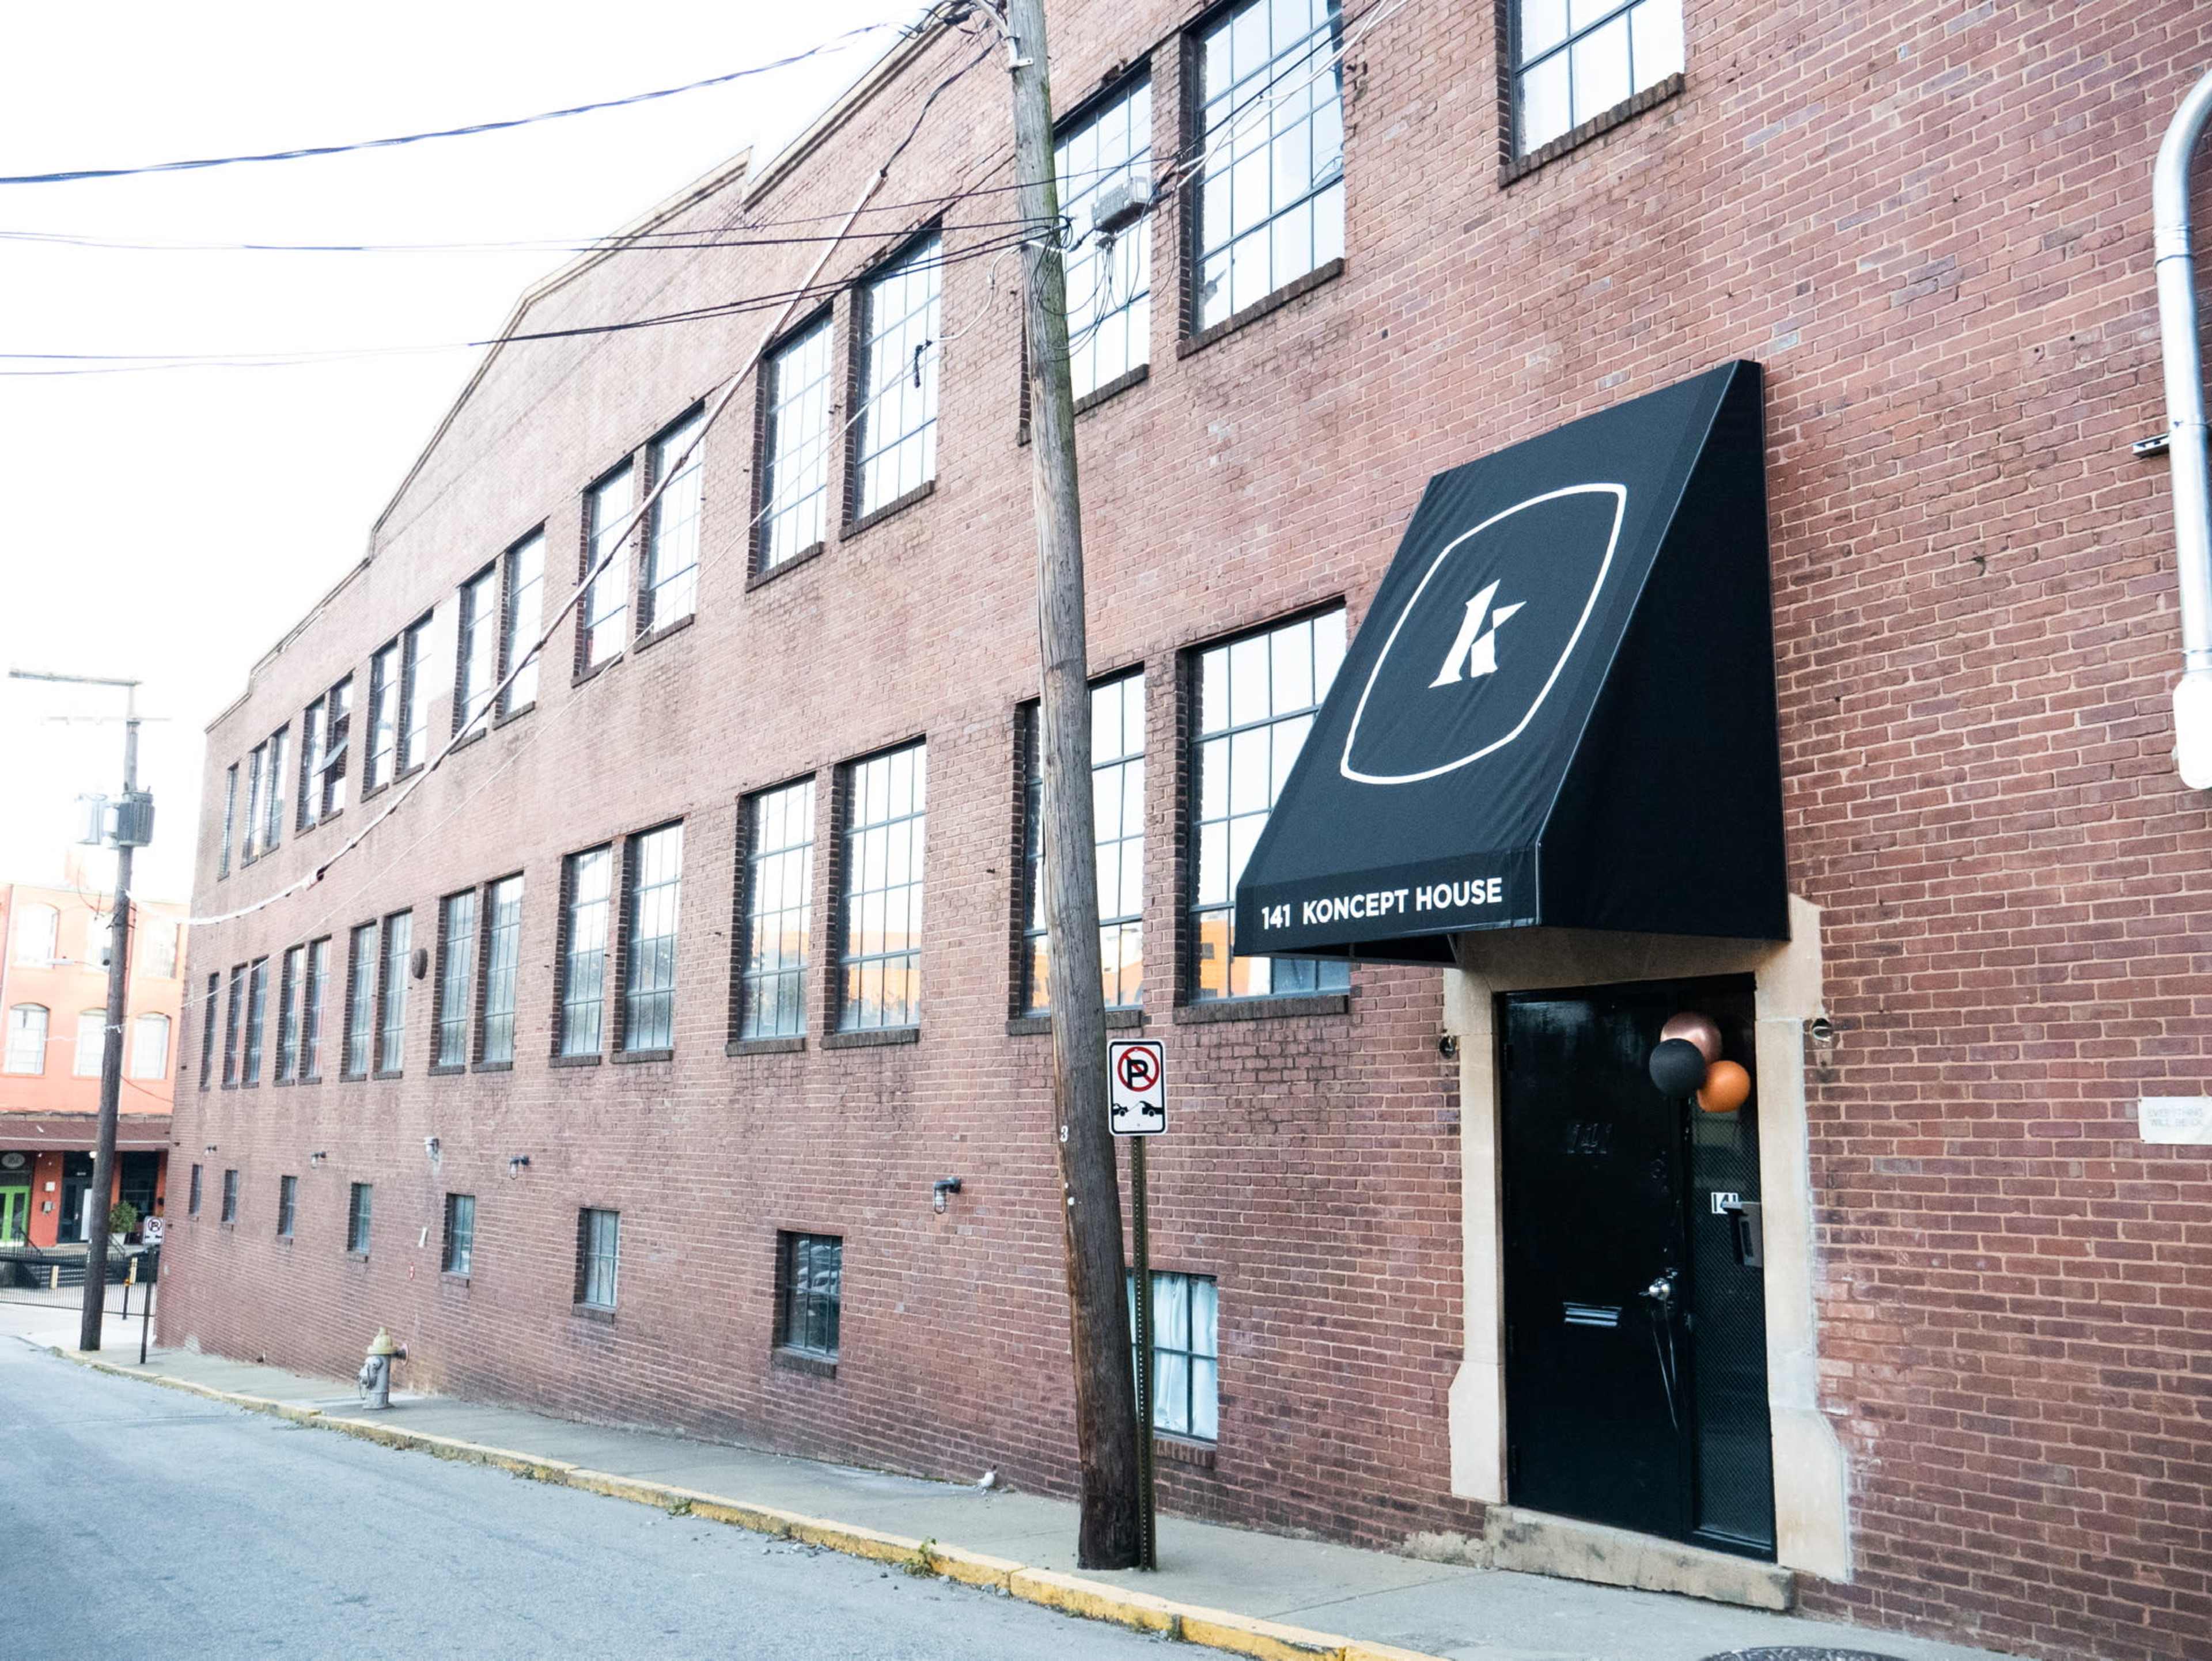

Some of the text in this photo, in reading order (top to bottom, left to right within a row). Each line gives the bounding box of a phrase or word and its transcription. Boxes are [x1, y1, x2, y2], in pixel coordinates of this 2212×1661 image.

[1262, 878, 1502, 929] 141 KONCEPT HOUSE
[1059, 1125, 1069, 1143] 3
